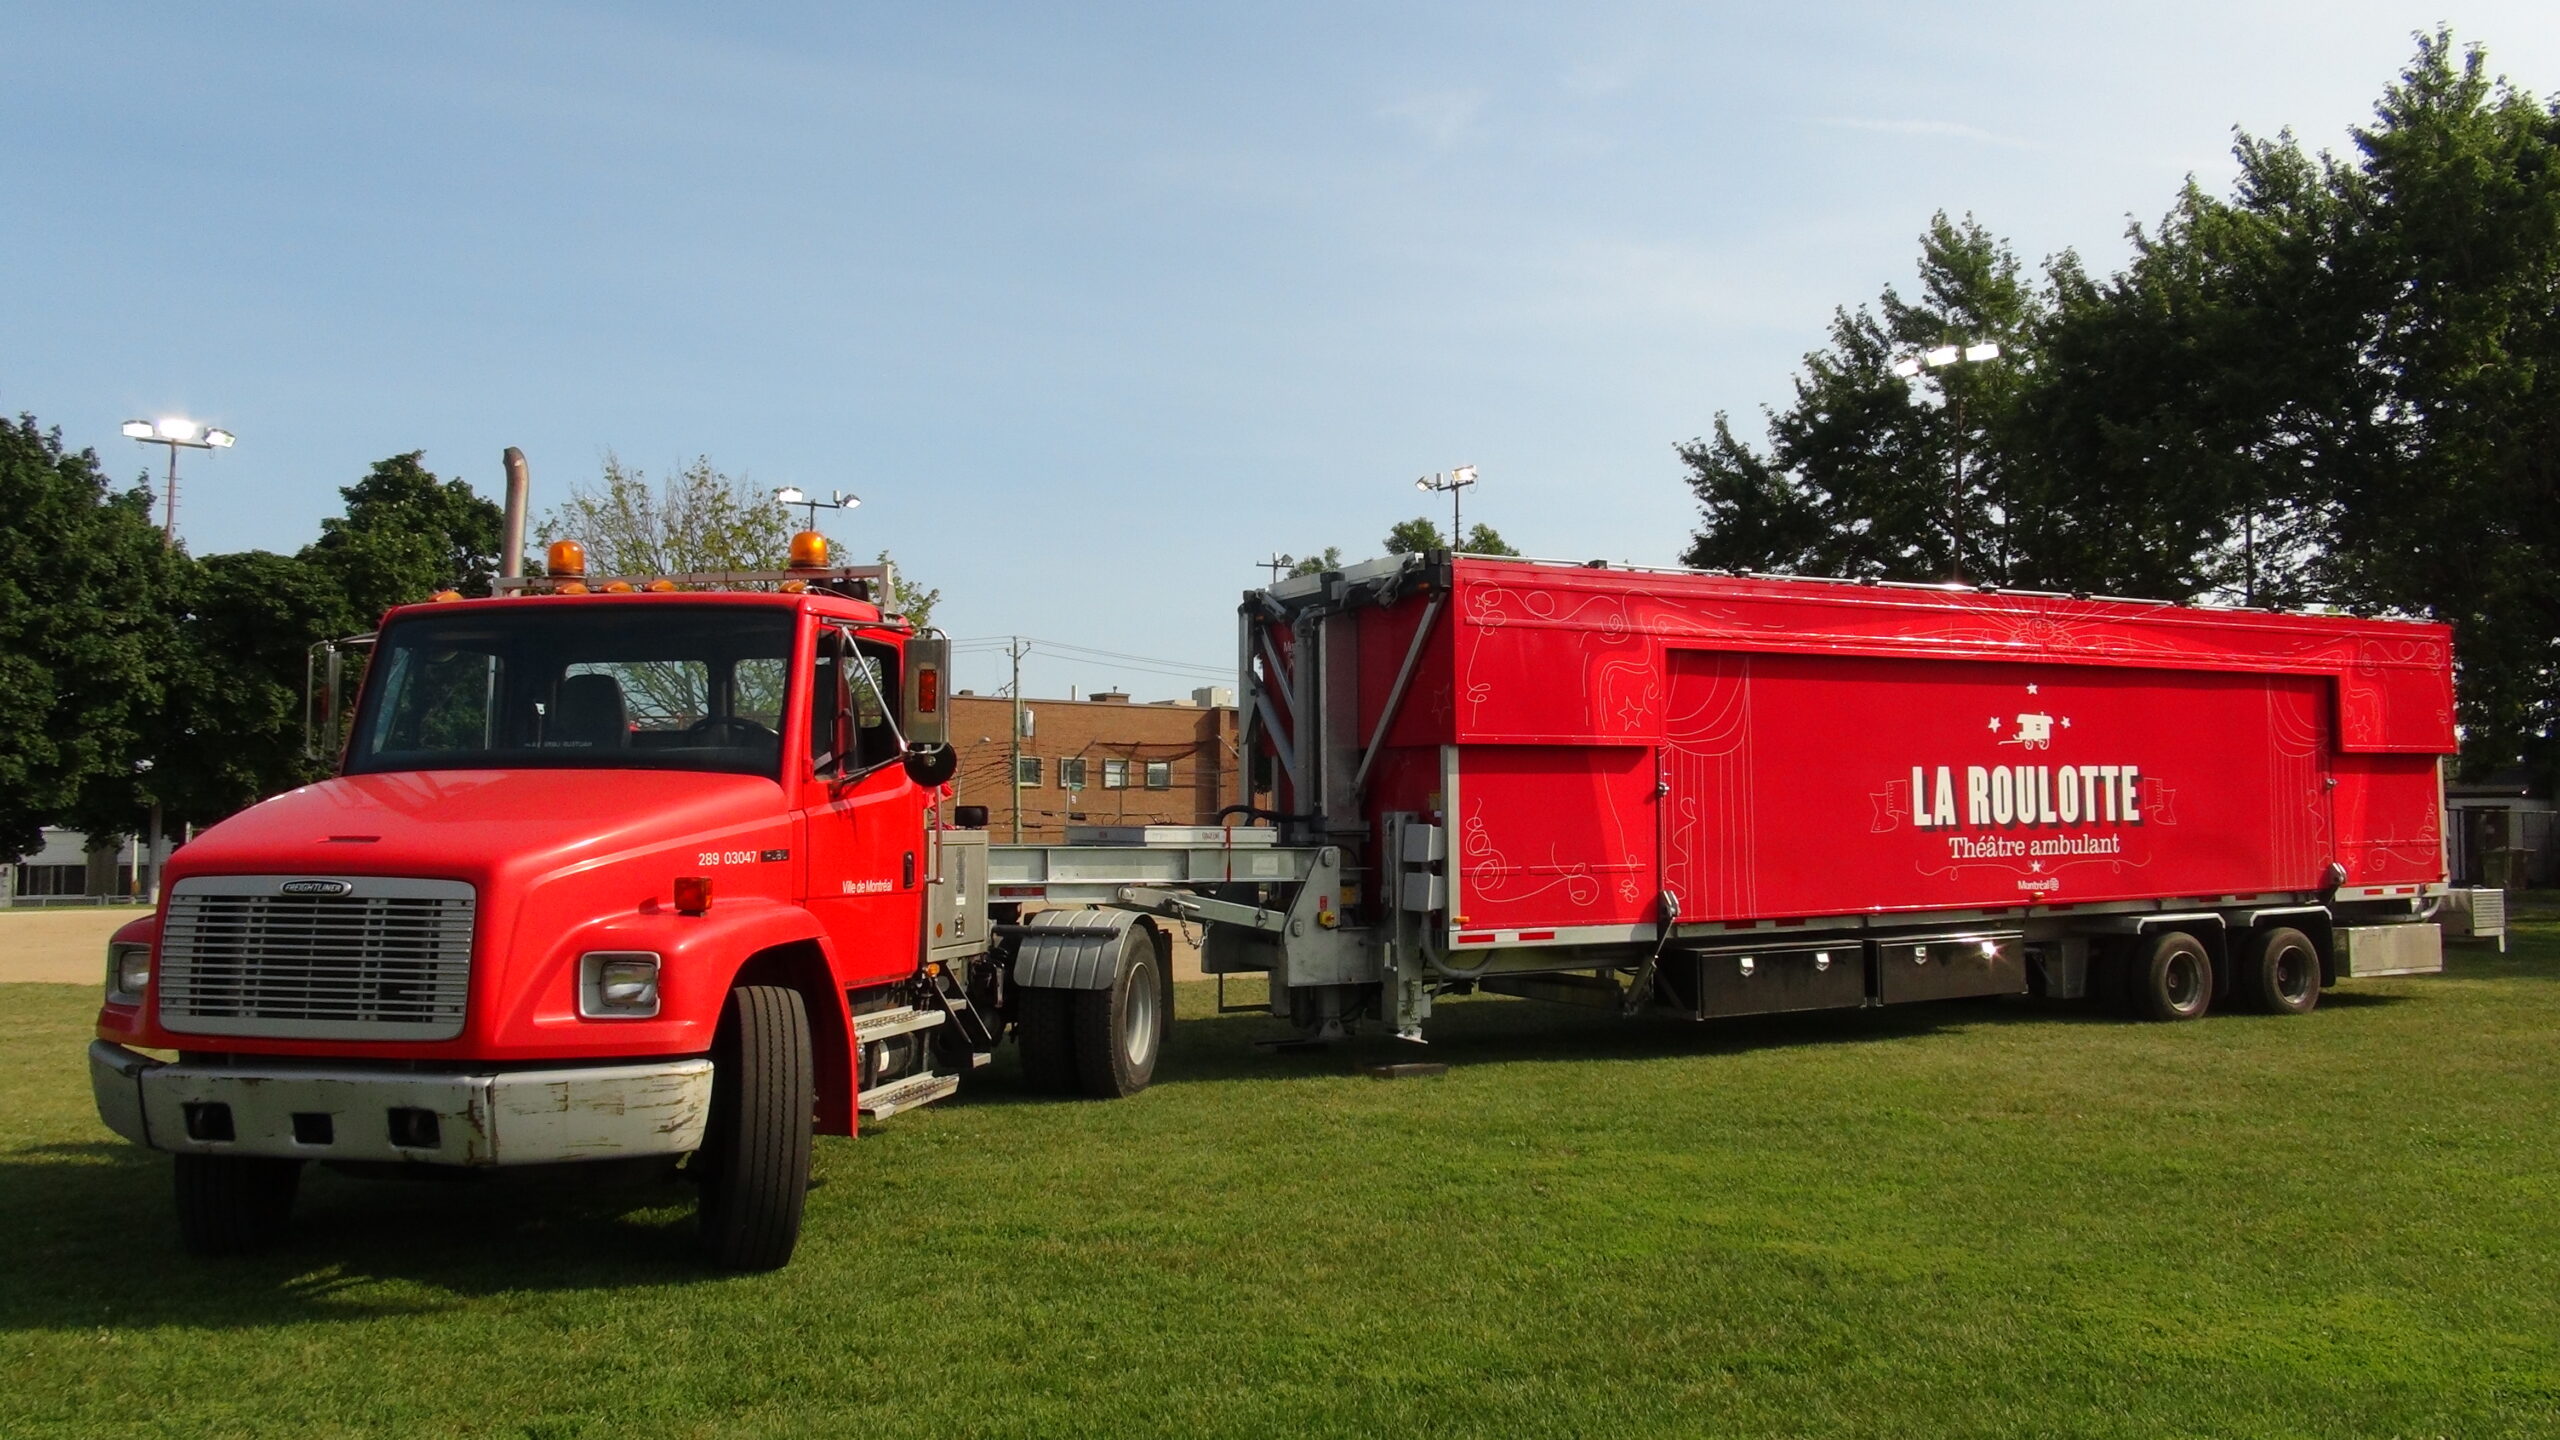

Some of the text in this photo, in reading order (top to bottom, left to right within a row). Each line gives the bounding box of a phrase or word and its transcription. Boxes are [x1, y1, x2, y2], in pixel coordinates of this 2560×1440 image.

[1911, 765, 2140, 826] LA ROULOTTE
[1949, 833, 2120, 859] Théâtre ambulant
[698, 851, 757, 866] 289 03047
[842, 879, 893, 894] Ville de Montréal
[2017, 880, 2050, 890] Montréal
